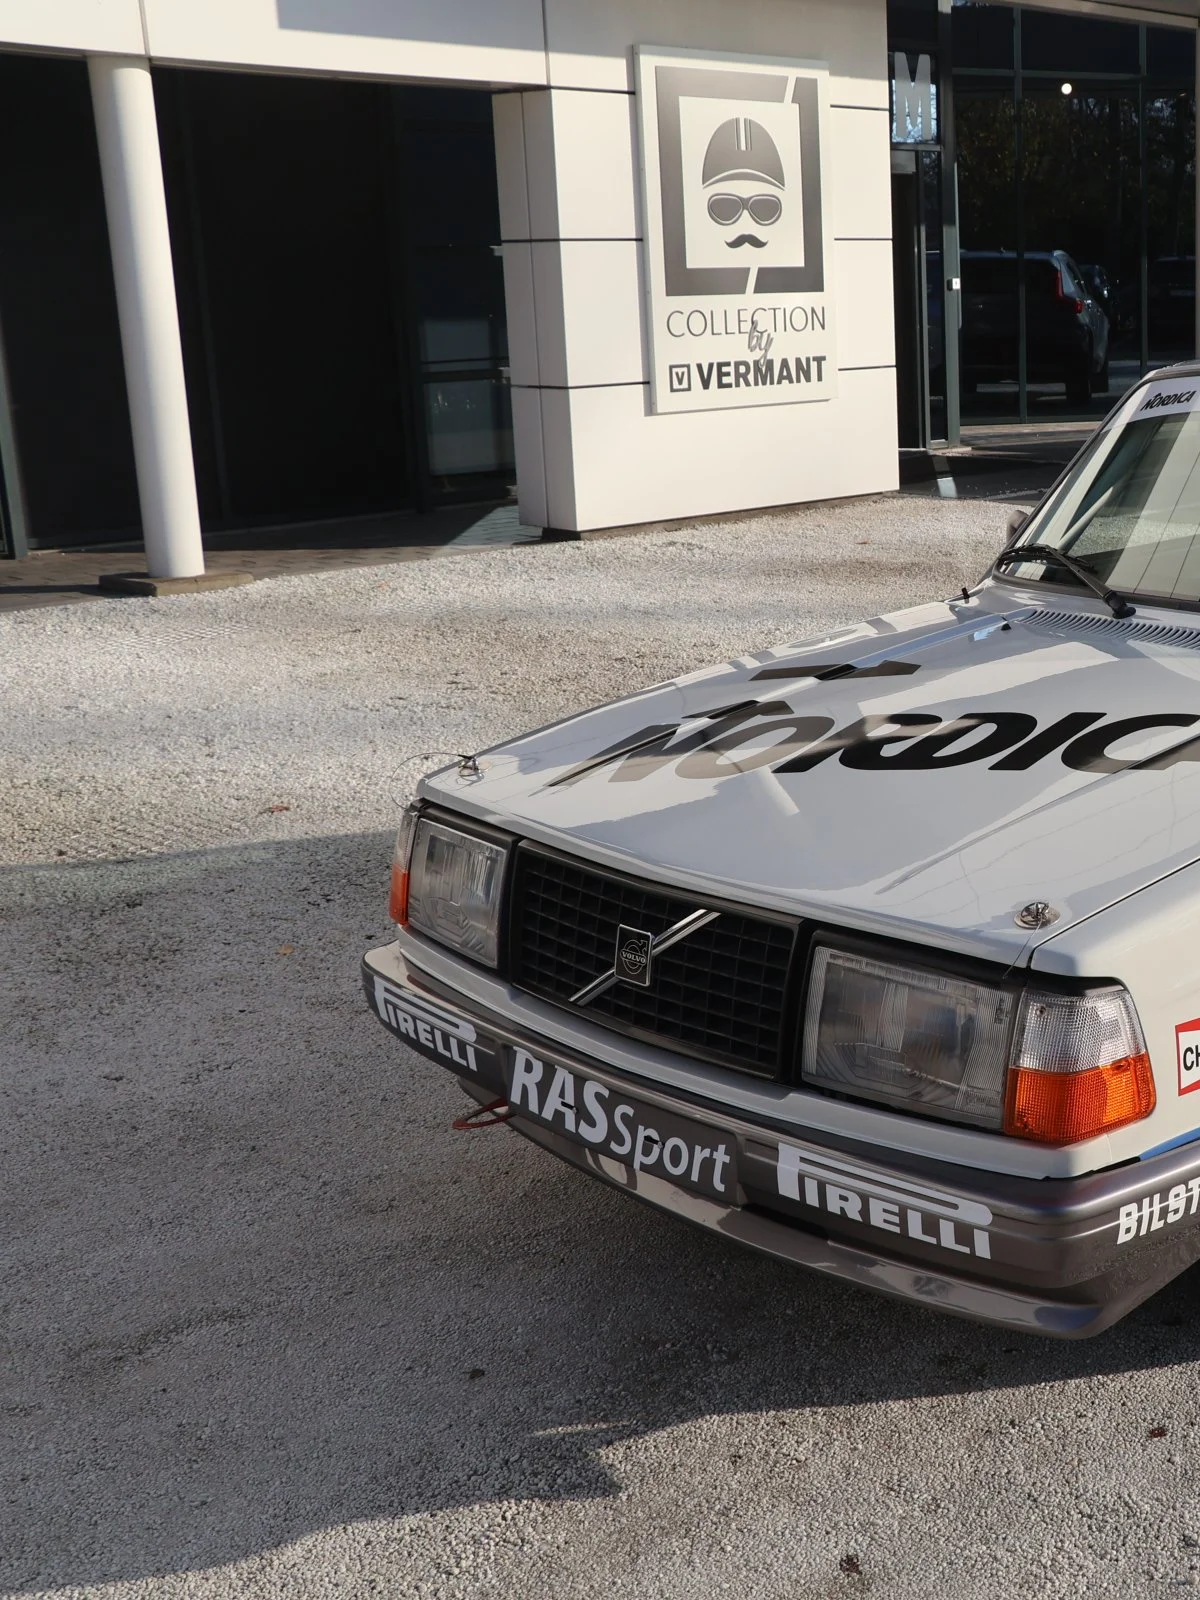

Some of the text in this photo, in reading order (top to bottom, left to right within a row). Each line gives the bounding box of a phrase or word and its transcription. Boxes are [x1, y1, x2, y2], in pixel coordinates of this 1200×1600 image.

[893, 51, 932, 140] M
[667, 306, 826, 338] COLLECTION
[748, 319, 774, 368] by
[696, 355, 827, 390] VERMANT
[1140, 391, 1196, 411] NORDICA
[622, 951, 646, 964] VOLVO
[373, 975, 478, 1072] PIRELLI
[776, 1141, 994, 1260] PIRELLI
